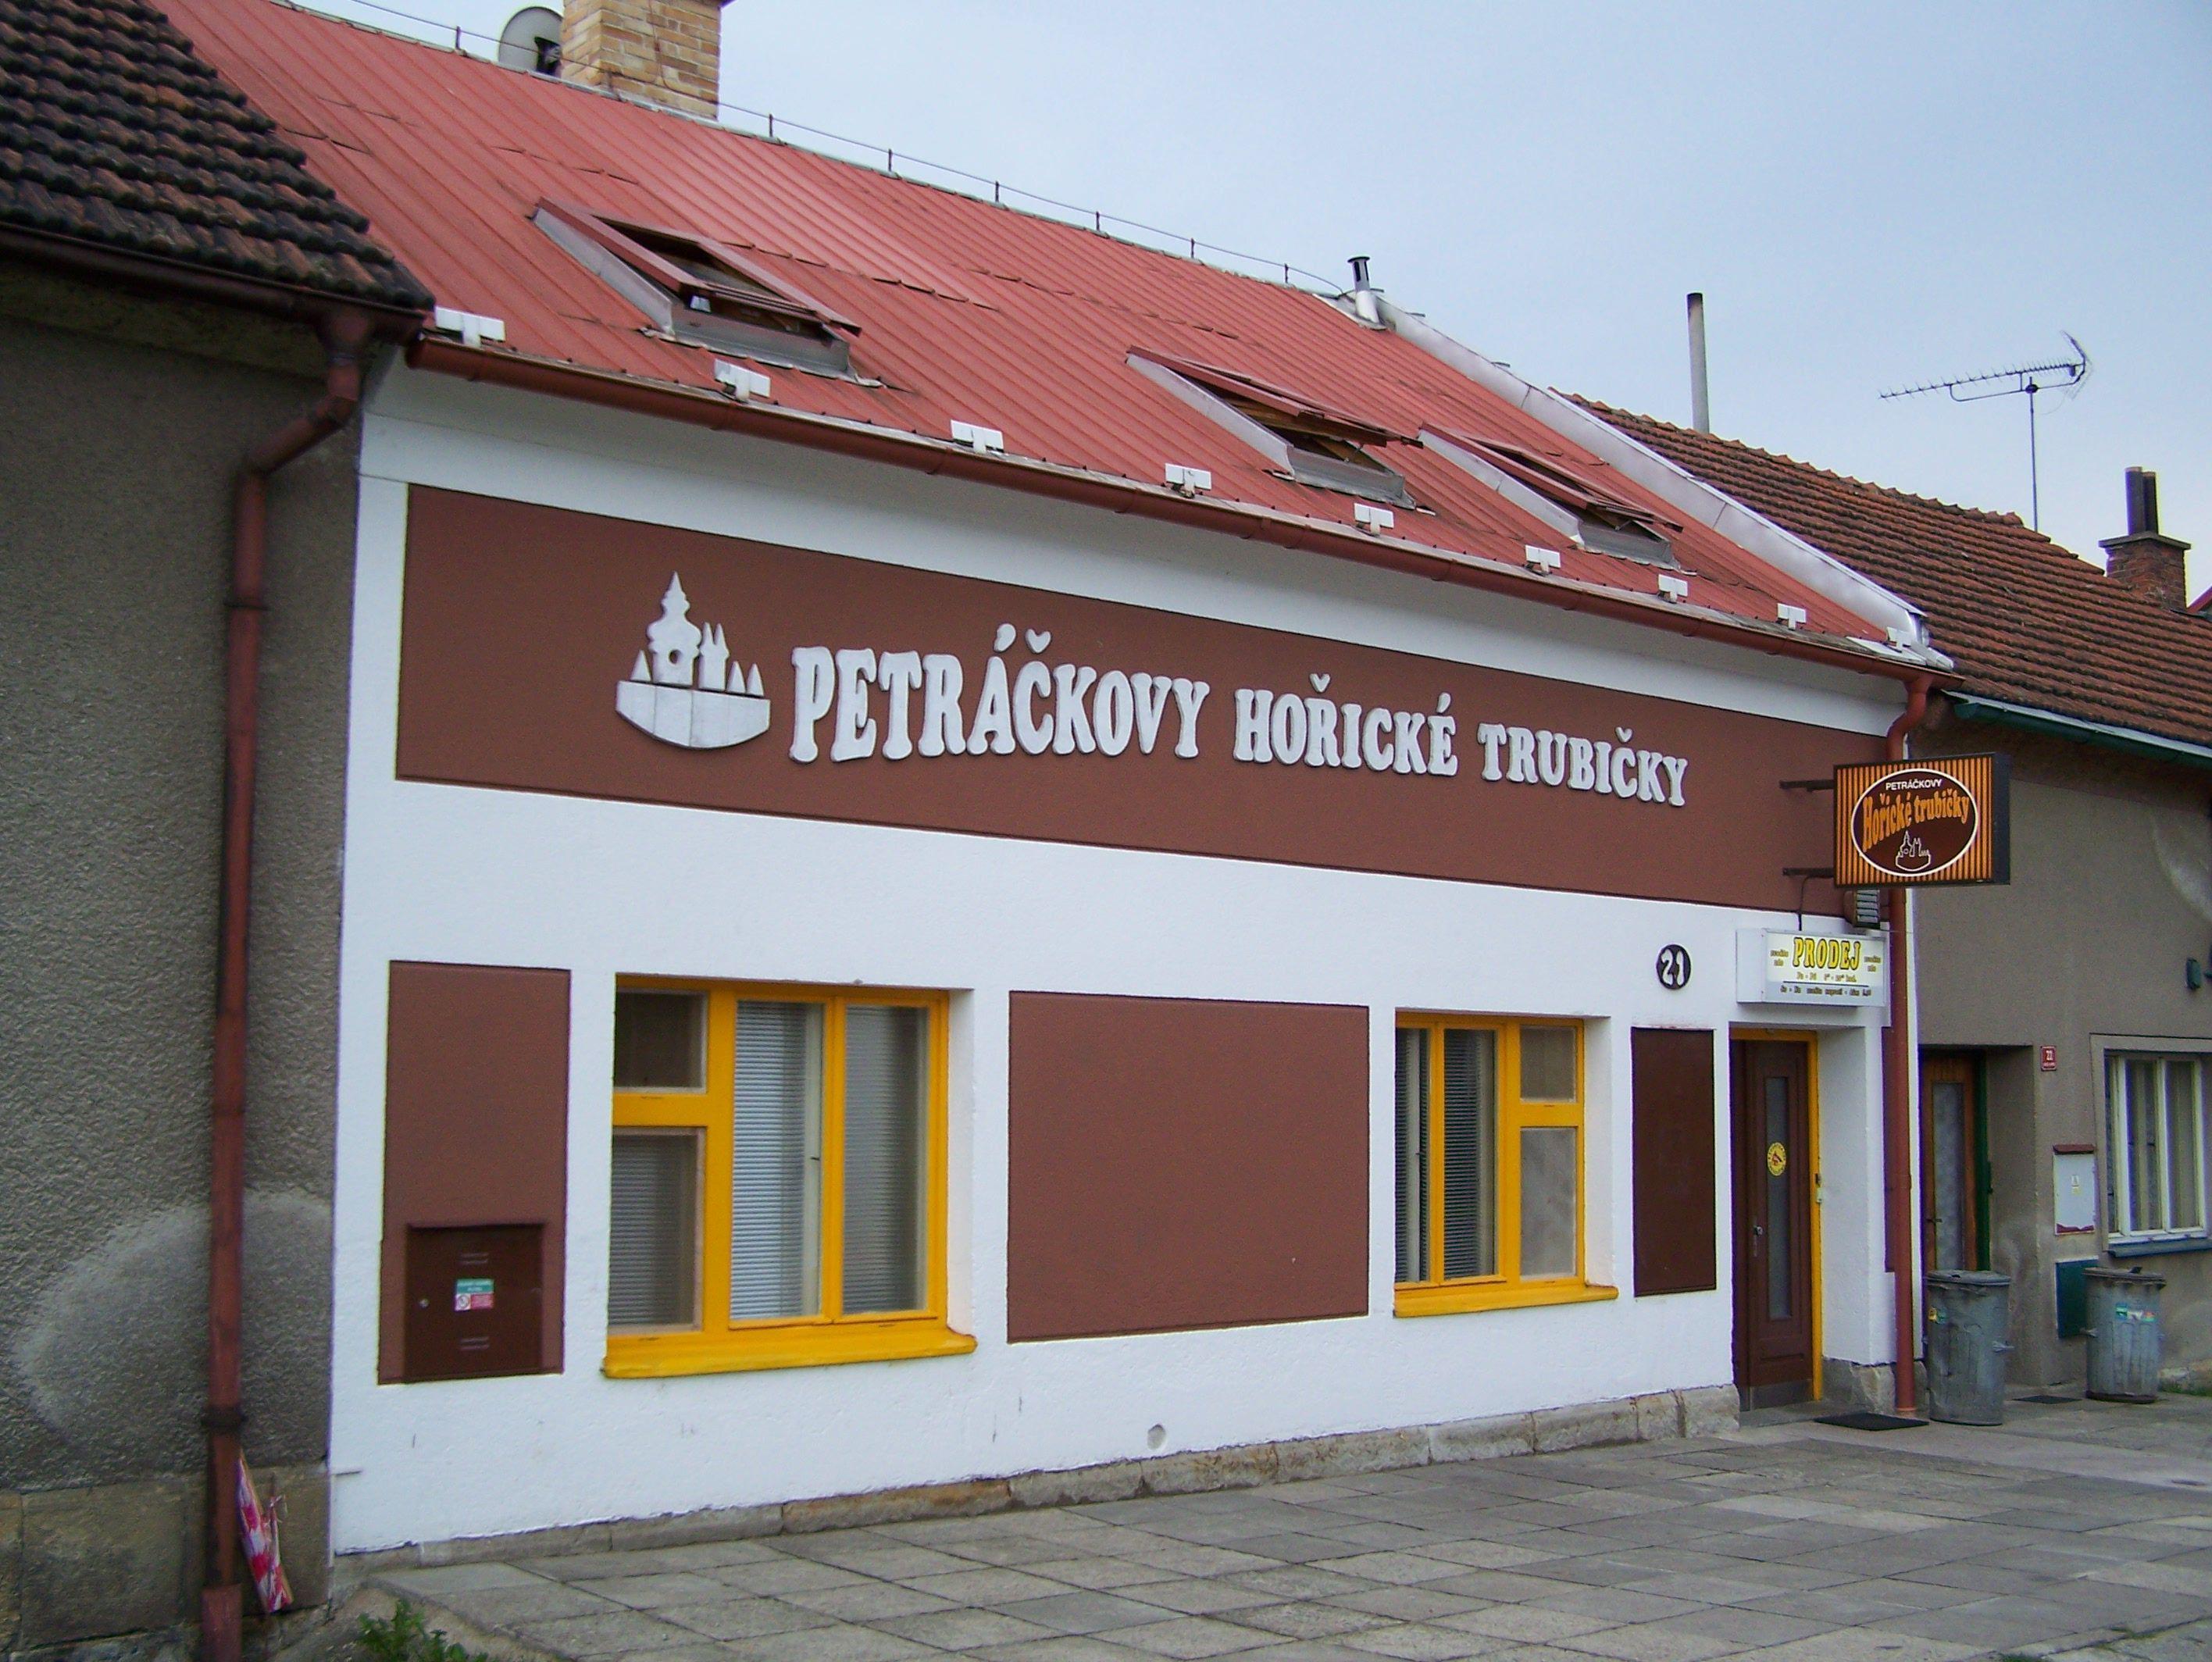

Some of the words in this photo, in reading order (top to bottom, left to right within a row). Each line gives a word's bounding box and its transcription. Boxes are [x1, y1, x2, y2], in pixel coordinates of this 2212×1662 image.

[789, 623, 1210, 762] PETRÁČKOVY
[1233, 673, 1458, 776] HOŘICKÉ
[1478, 722, 1688, 806] TRUBIČKY
[1886, 779, 1943, 790] PETRÁČKOVY
[1862, 792, 1913, 852] Hořické
[1914, 788, 1970, 824] trubičky
[1661, 948, 1685, 986] 21
[1792, 936, 1861, 970] PRODEJ
